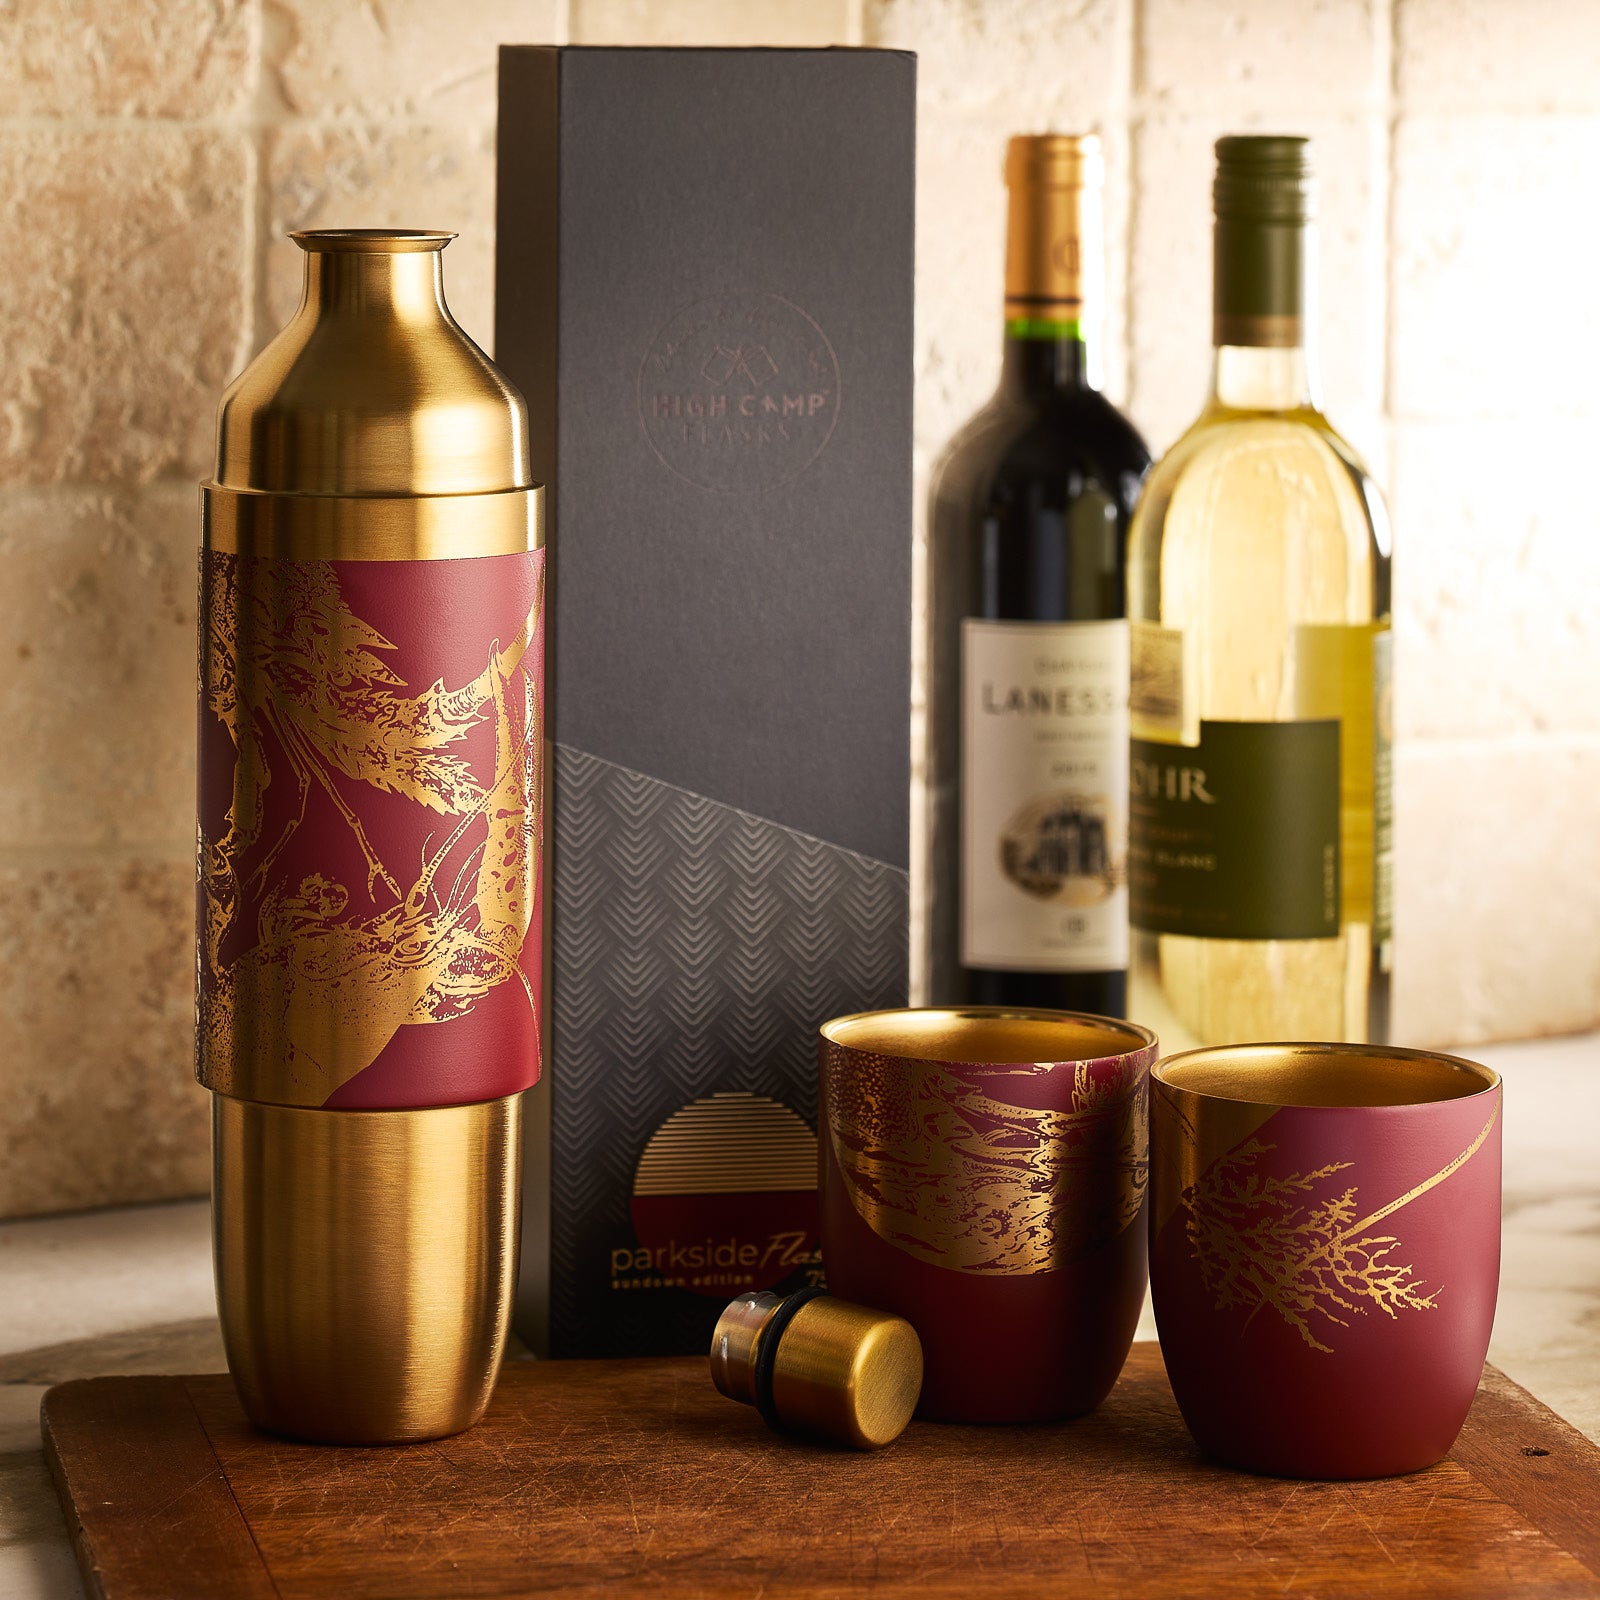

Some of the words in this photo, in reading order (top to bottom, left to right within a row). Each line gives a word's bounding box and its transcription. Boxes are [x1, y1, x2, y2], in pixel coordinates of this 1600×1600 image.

[652, 394, 728, 418] HIGH
[738, 393, 827, 418] CAMP
[611, 1238, 759, 1277] parkside
[612, 1276, 686, 1290] sundown
[692, 1273, 754, 1287] edition
